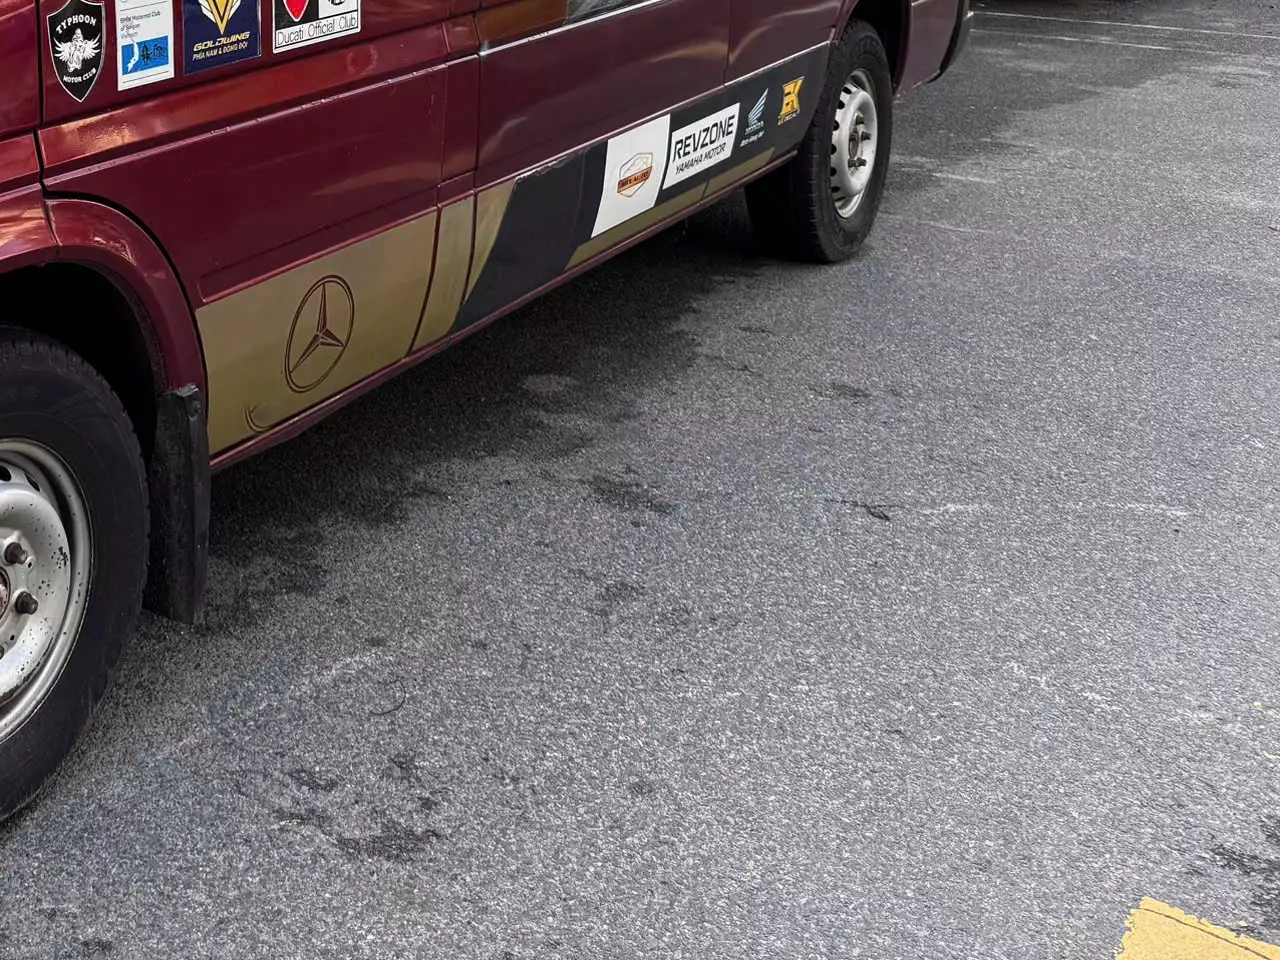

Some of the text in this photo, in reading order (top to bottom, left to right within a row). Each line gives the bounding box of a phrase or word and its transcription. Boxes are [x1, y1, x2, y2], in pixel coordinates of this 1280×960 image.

[55, 14, 97, 34] TYPHOON
[277, 14, 356, 46] Ducati Official Club
[193, 31, 251, 52] GOLDWING
[63, 67, 97, 83] MOTOR CLUB
[672, 114, 736, 163] REVZONE
[675, 142, 726, 175] YAMAHA MOTOR
